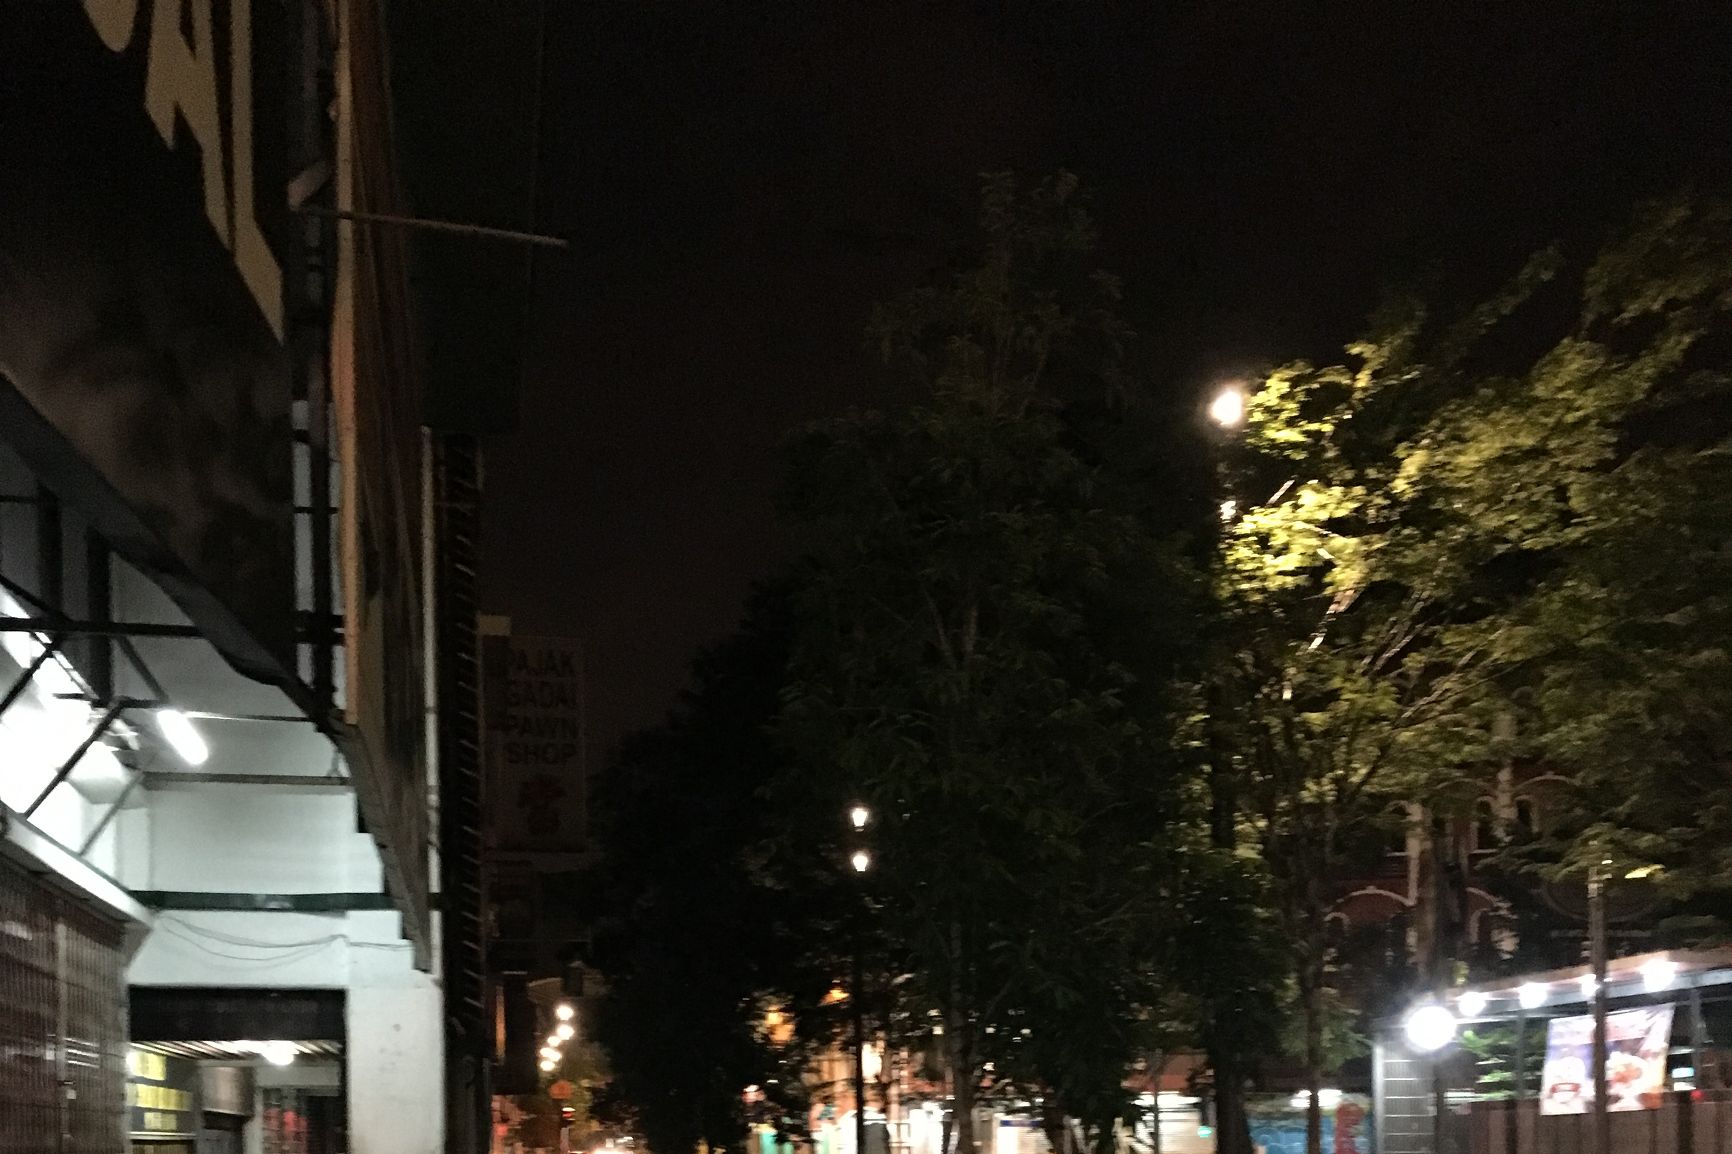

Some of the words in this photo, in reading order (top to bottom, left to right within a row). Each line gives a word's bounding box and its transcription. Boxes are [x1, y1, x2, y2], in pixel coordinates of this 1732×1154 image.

[504, 649, 575, 677] PAJAK
[506, 680, 577, 709] GADAI
[505, 714, 578, 739] PAWN
[503, 742, 577, 764] SHOP
